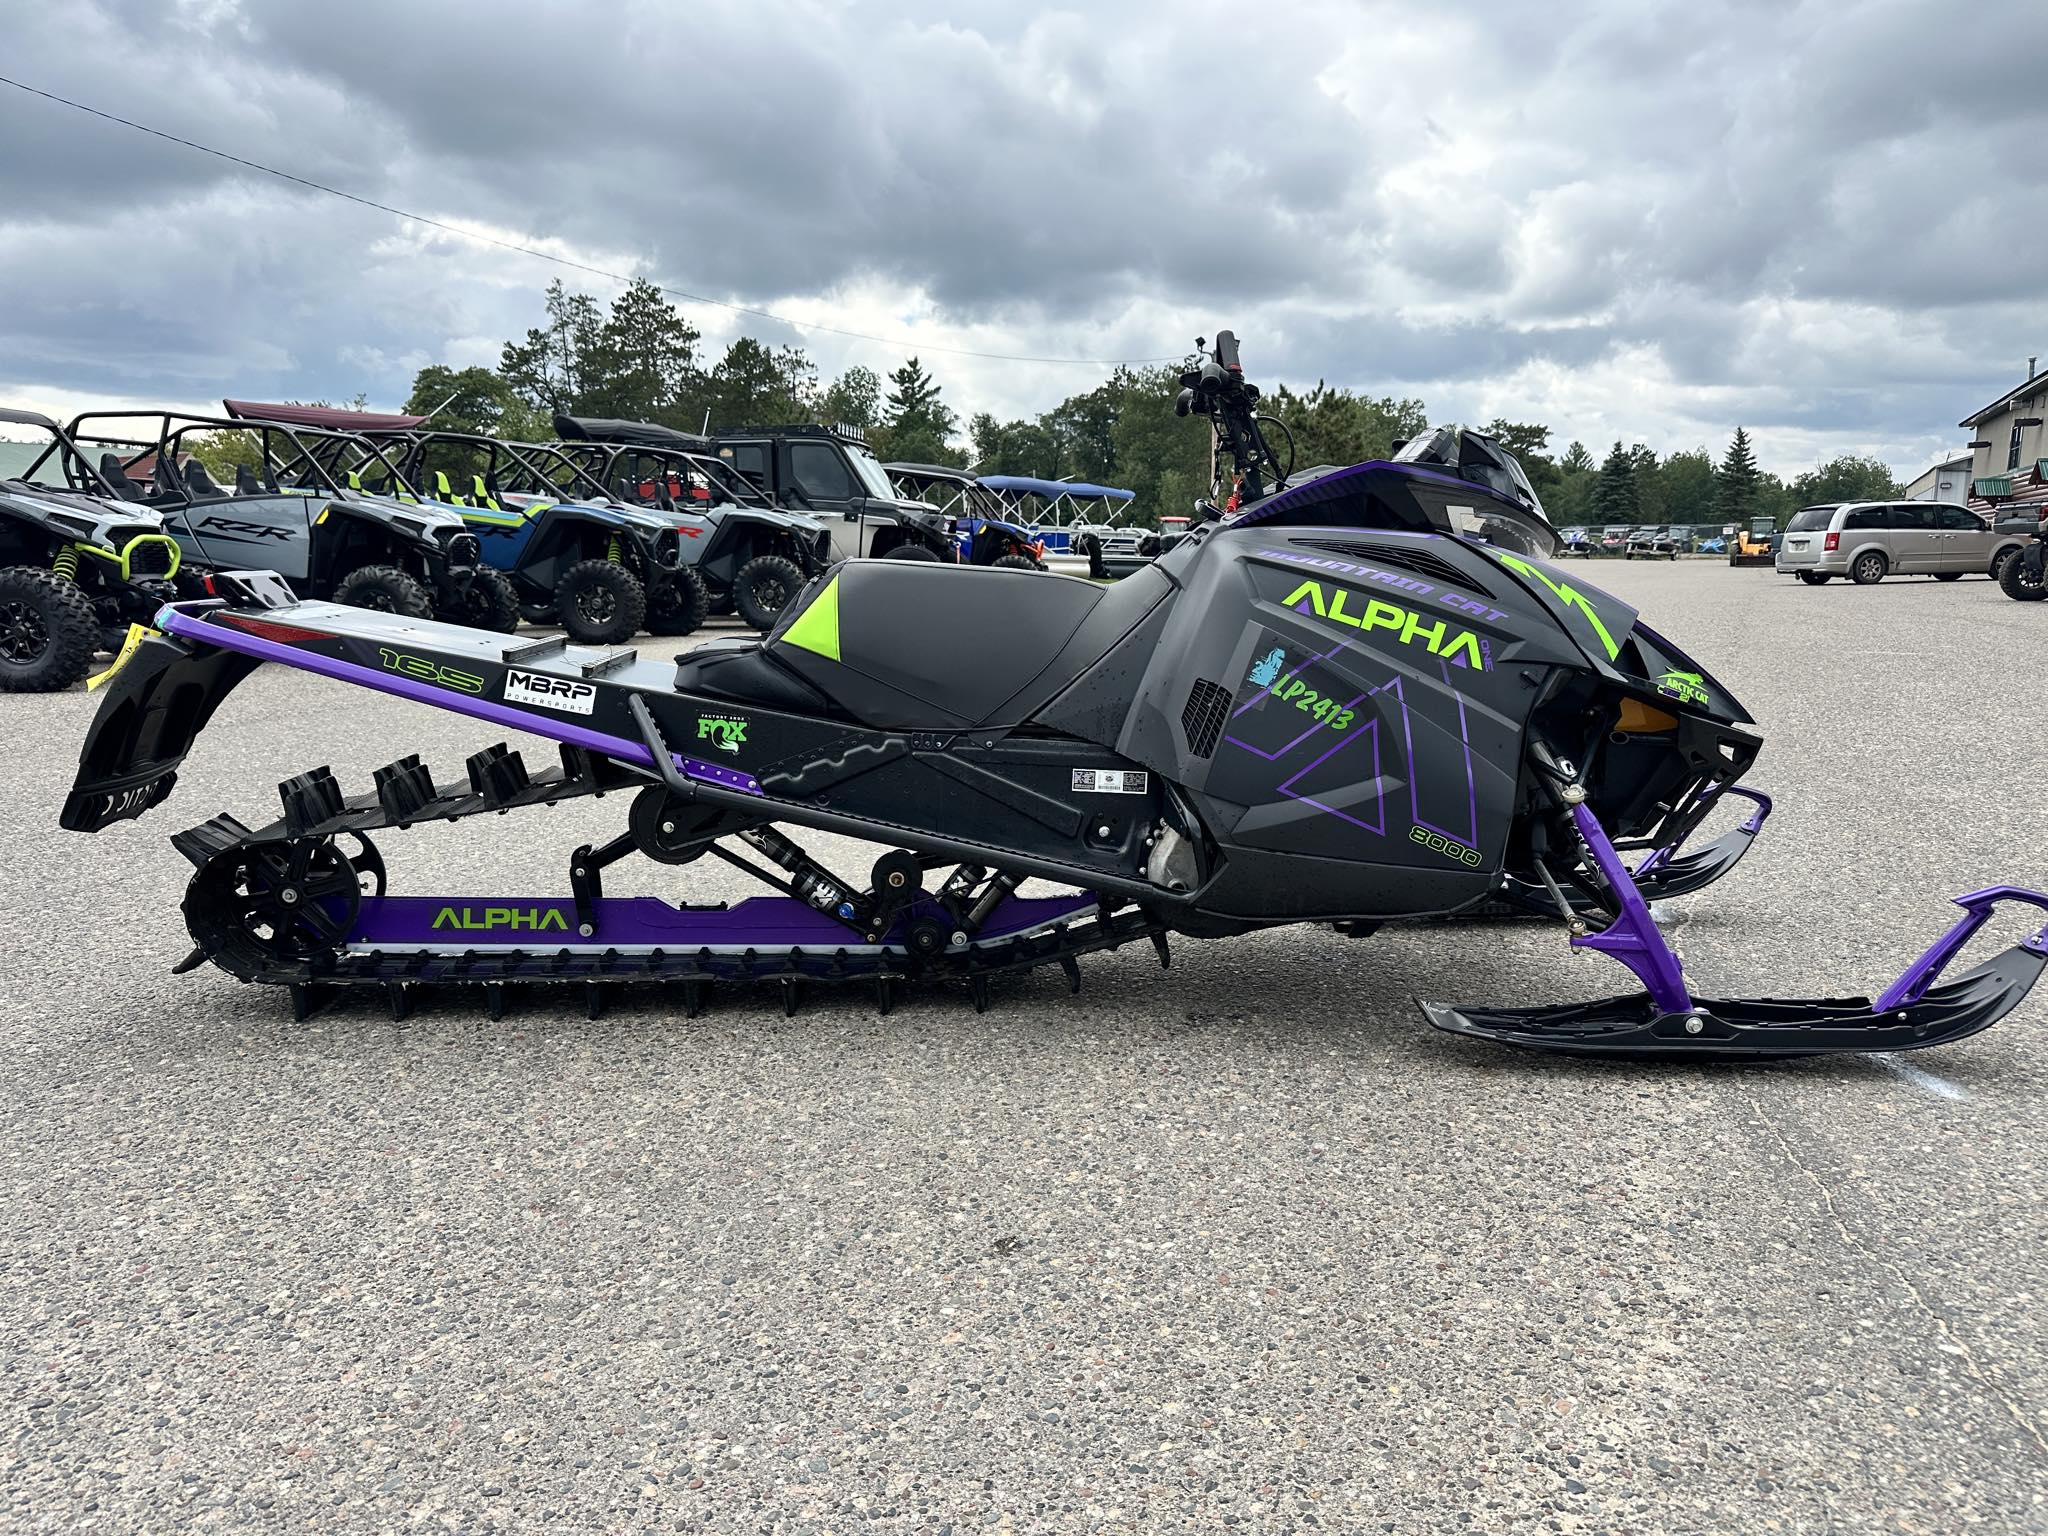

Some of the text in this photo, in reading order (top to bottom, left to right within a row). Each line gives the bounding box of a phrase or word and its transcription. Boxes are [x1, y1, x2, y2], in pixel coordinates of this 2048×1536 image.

[197, 516, 297, 541] RZR
[1257, 549, 1510, 622] MOUNTAIN CAT
[1281, 581, 1483, 671] ALPHA
[379, 648, 485, 693] 165
[1480, 640, 1494, 673] ONE
[508, 671, 593, 700] MBRP
[1665, 678, 1695, 698] ARCTIC
[1695, 690, 1710, 704] CAT
[507, 692, 591, 714] POWERSPORTS
[1271, 673, 1355, 730] LP2413
[697, 718, 748, 747] FOX
[1408, 825, 1482, 867] 8000
[431, 907, 569, 930] ALPHA
